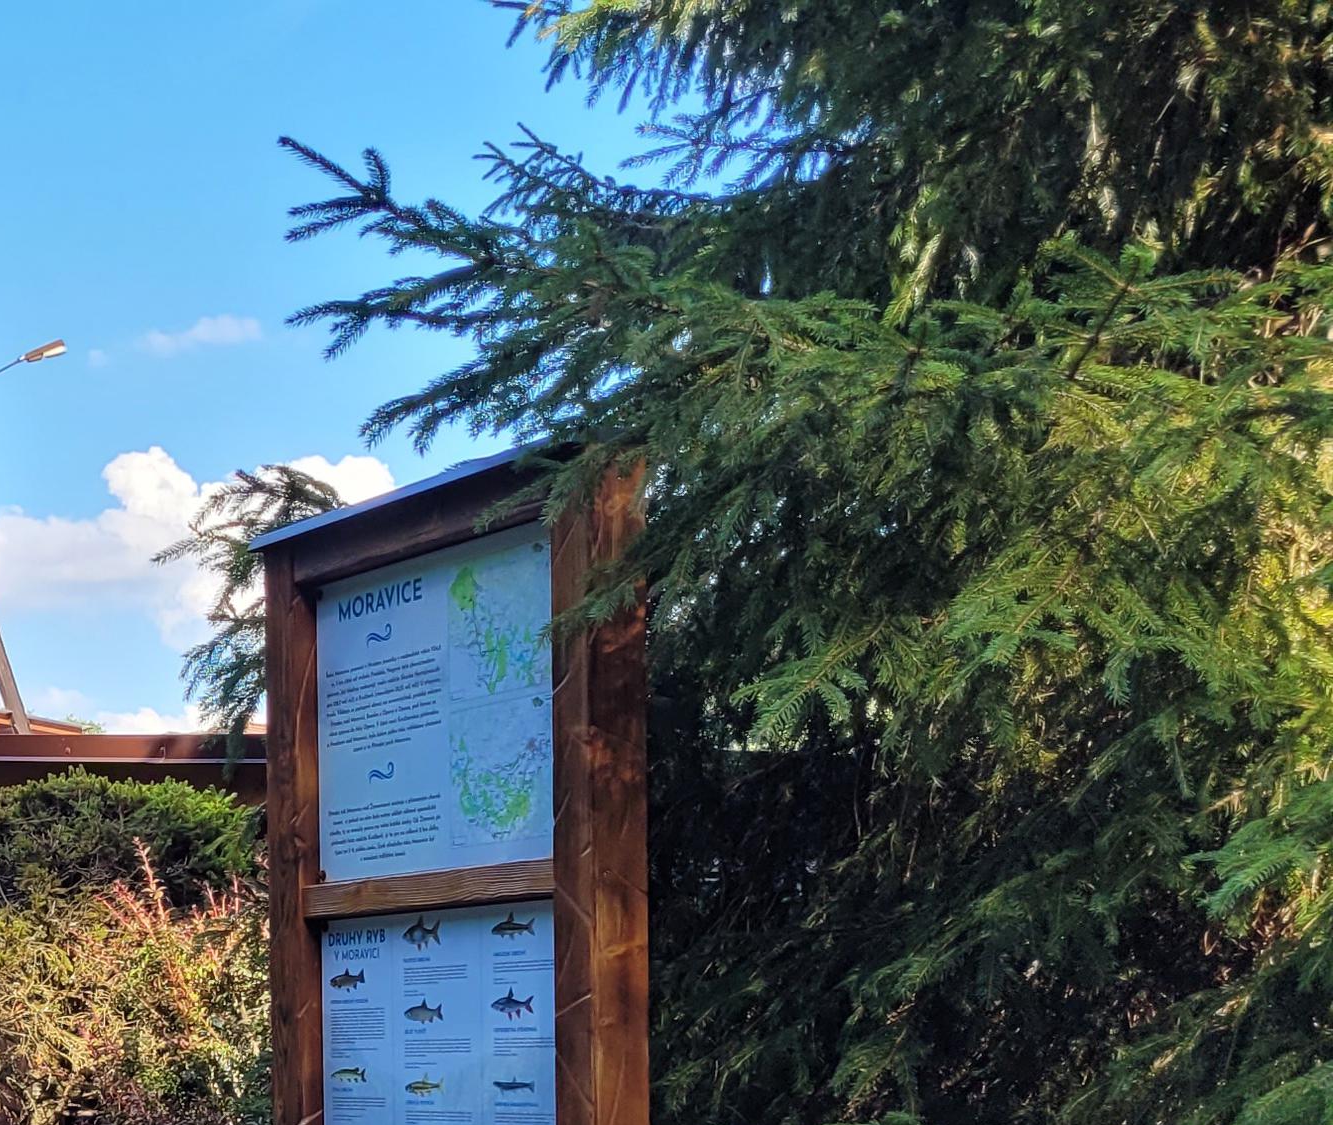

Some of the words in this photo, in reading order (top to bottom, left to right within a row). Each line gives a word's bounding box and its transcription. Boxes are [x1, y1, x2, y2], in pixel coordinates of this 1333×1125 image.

[338, 577, 422, 622] MORAVICE
[328, 929, 362, 947] DRUHY
[366, 928, 386, 944] RYB
[341, 947, 381, 961] MORAVICI
